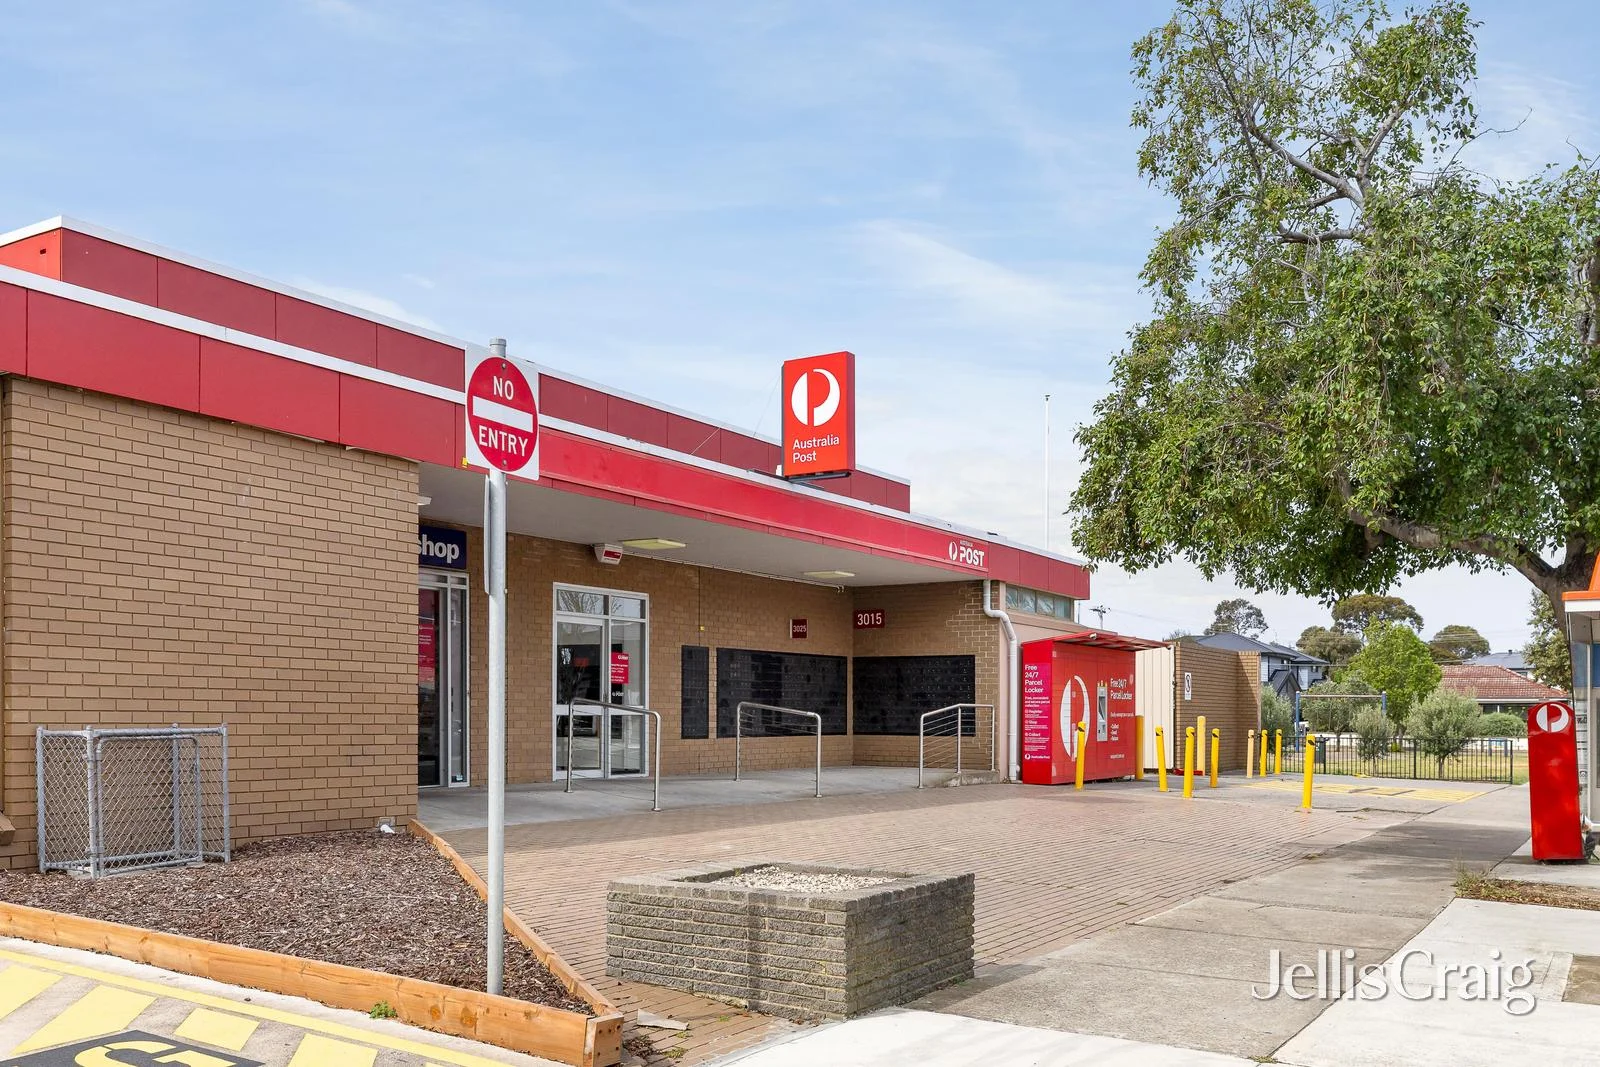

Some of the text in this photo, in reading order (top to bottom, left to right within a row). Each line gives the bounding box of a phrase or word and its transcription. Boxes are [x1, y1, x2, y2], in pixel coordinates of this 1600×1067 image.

[493, 375, 514, 400] NO
[479, 424, 528, 457] ENTRY
[793, 434, 840, 450] Australia
[793, 450, 817, 463] Post
[960, 545, 985, 567] POST
[857, 612, 882, 626] 3015
